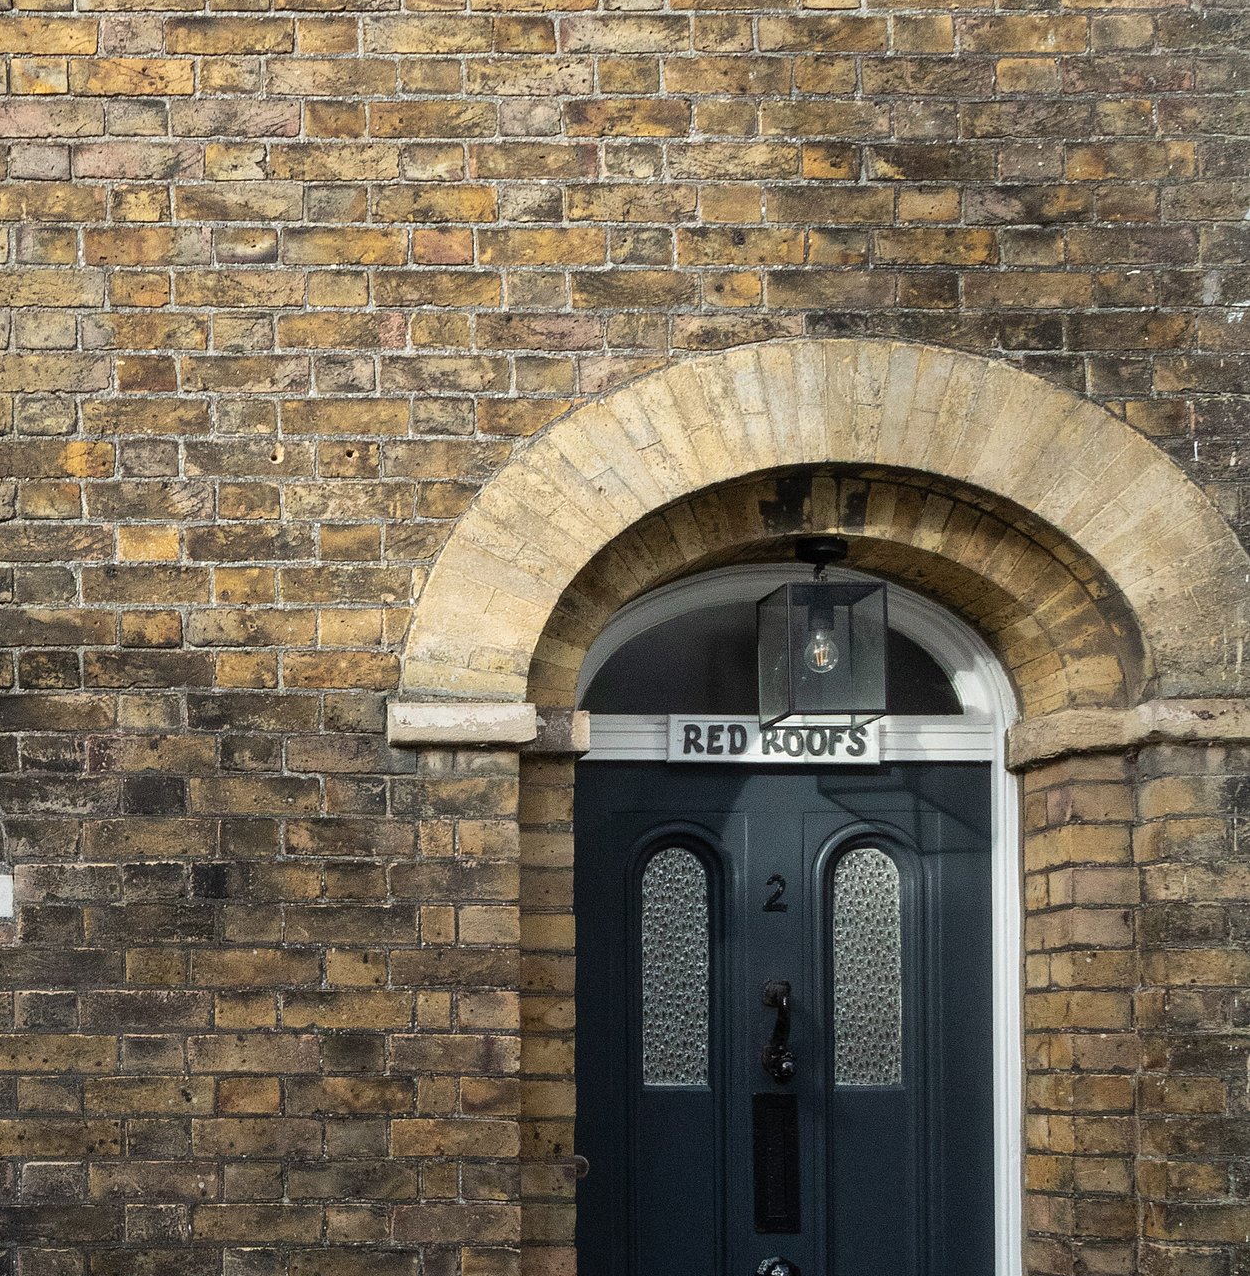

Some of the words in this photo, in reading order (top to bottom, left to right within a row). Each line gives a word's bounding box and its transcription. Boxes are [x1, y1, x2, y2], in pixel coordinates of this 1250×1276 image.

[683, 724, 748, 755] RED
[761, 726, 867, 756] ROOFS
[762, 873, 788, 913] 2
